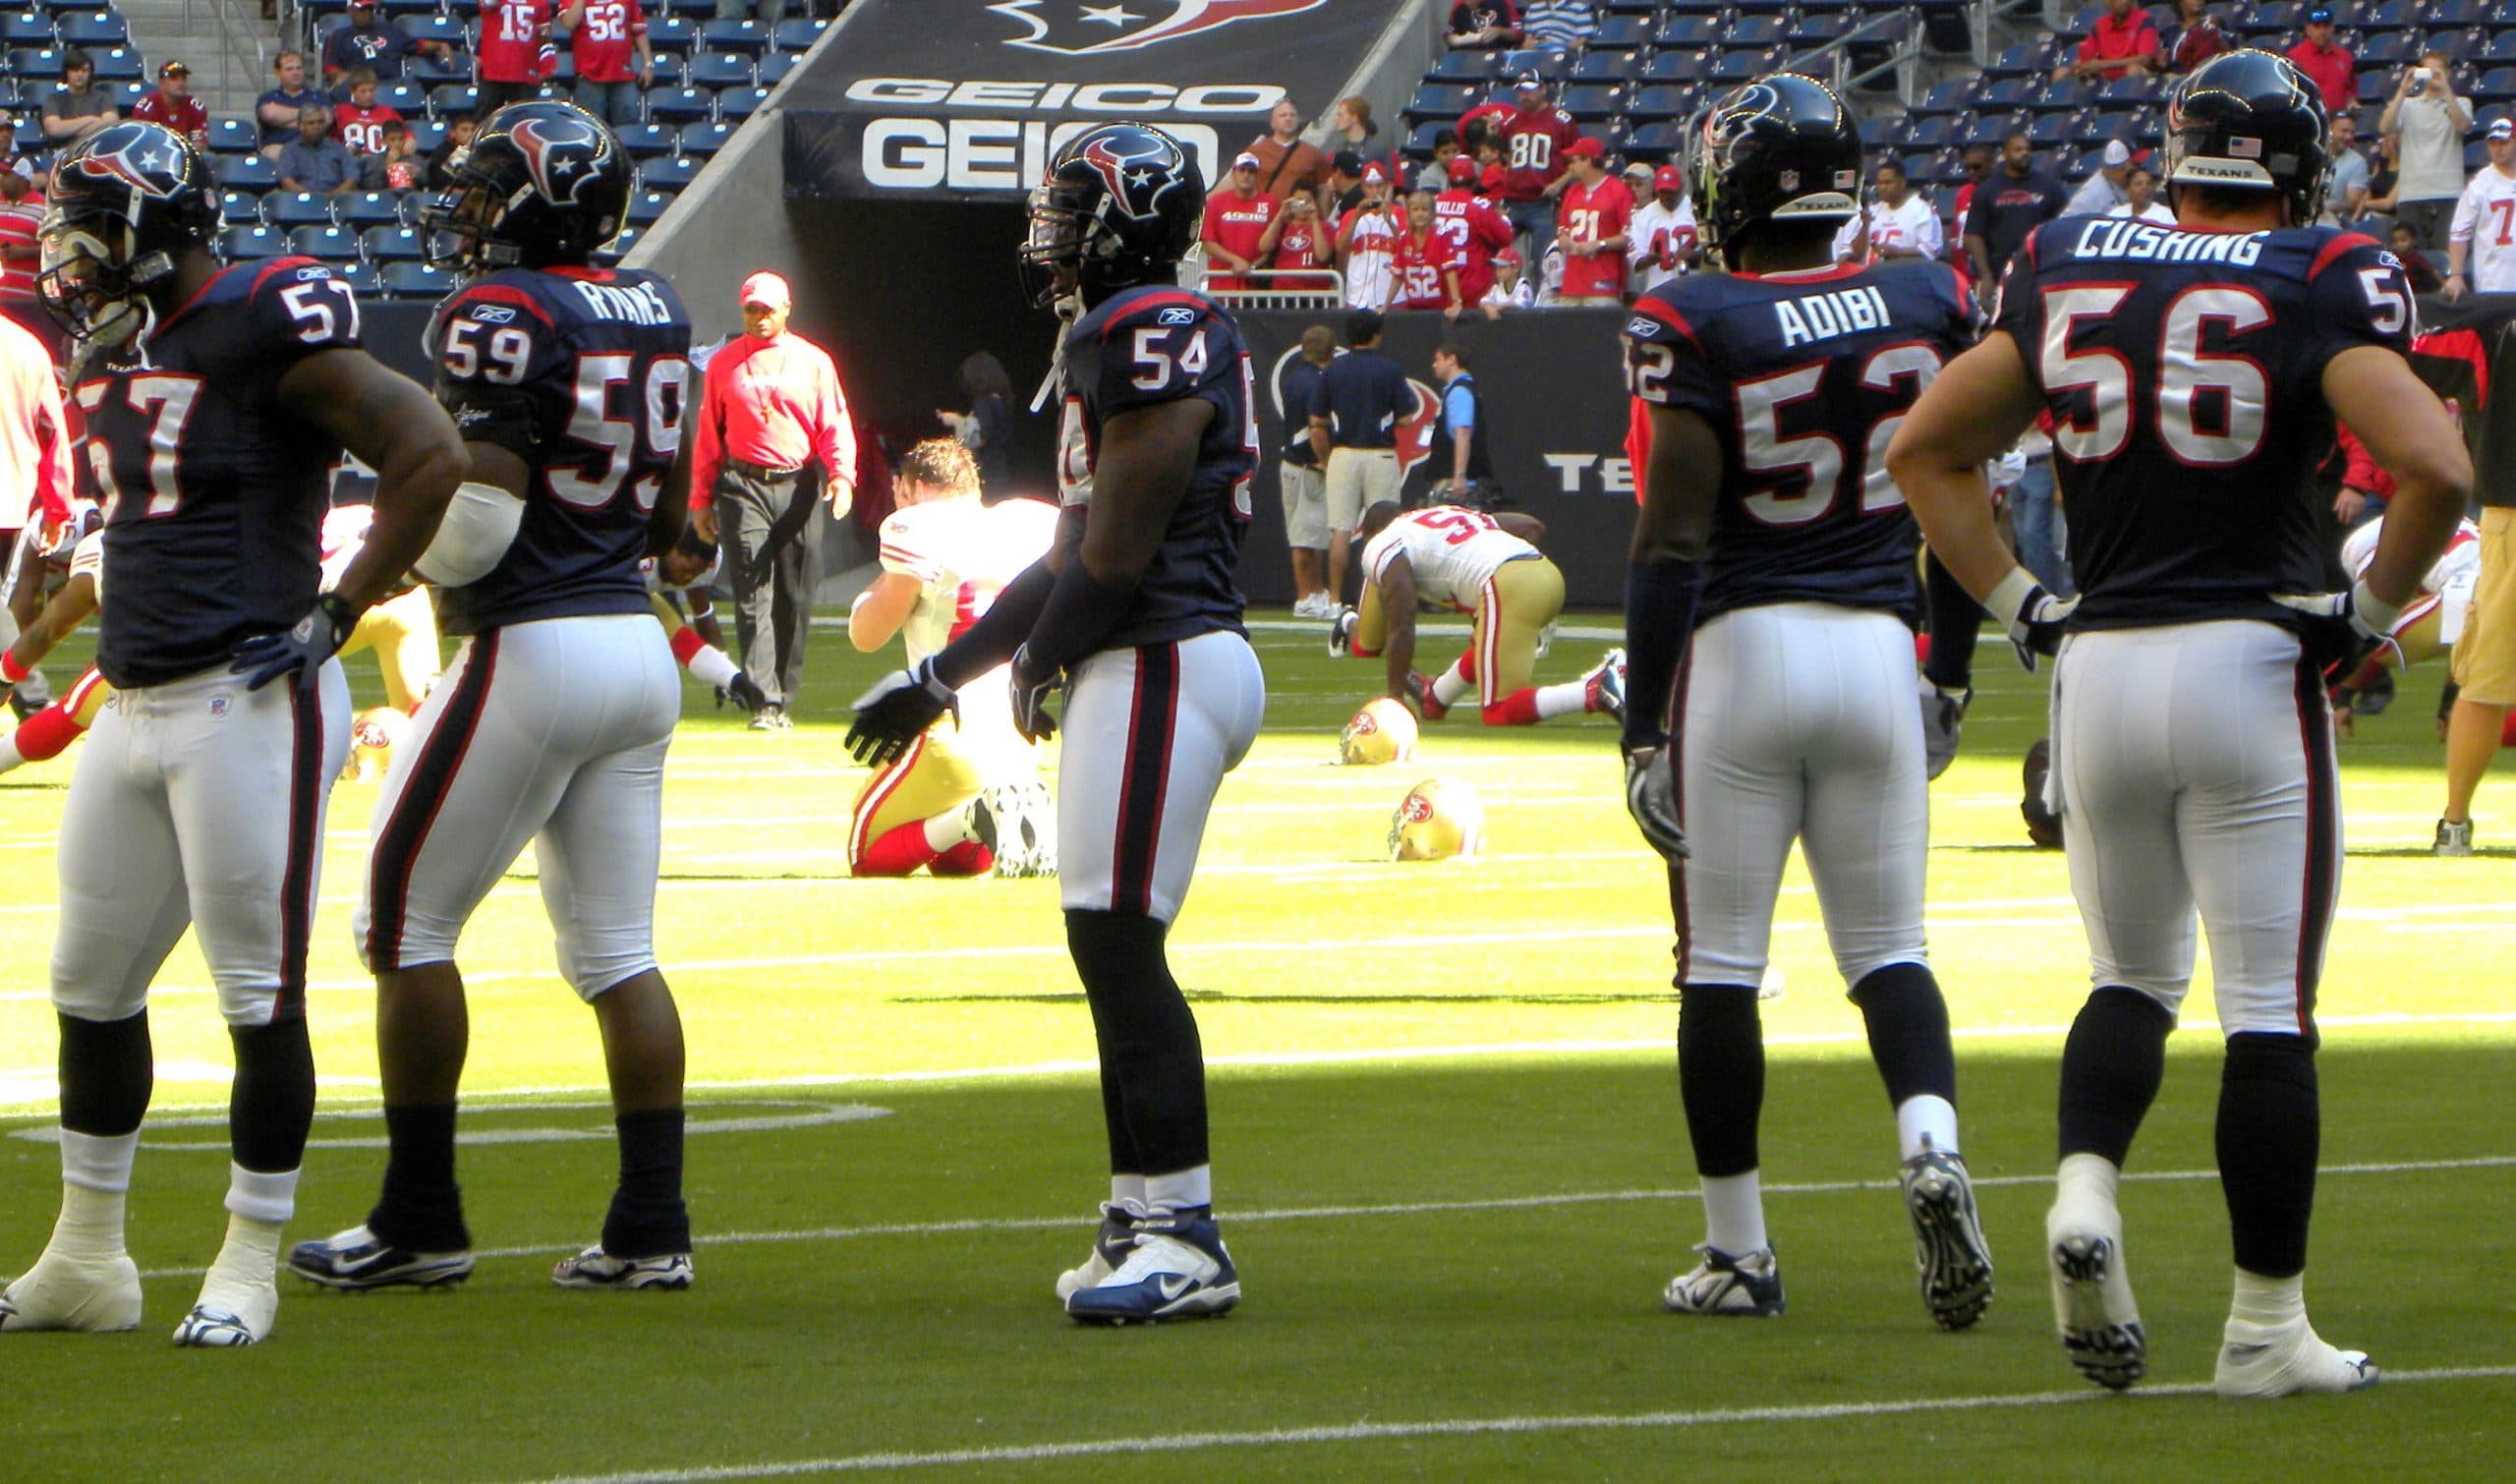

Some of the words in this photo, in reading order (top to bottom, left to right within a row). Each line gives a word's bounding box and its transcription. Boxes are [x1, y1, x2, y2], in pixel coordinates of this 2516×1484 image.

[499, 4, 536, 41] 15
[585, 3, 626, 41] 52
[844, 77, 1287, 112] GEICO
[344, 122, 387, 154] 80
[862, 118, 1219, 190] GEIO
[1511, 133, 1552, 169] 80
[2187, 165, 2253, 177] TEXANS
[1257, 201, 1269, 214] 15
[1570, 208, 1600, 242] 21
[2074, 219, 2271, 268] CUSHING
[573, 280, 672, 325] RYANS
[1406, 265, 1442, 299] 52
[2358, 266, 2424, 338] 5
[279, 277, 361, 344] 57
[1774, 284, 1891, 348] ADIBI
[444, 317, 534, 386] 59
[1131, 327, 1210, 391] 54
[2039, 281, 2276, 469] 56
[543, 350, 690, 515] 59
[1732, 339, 1946, 528] 52
